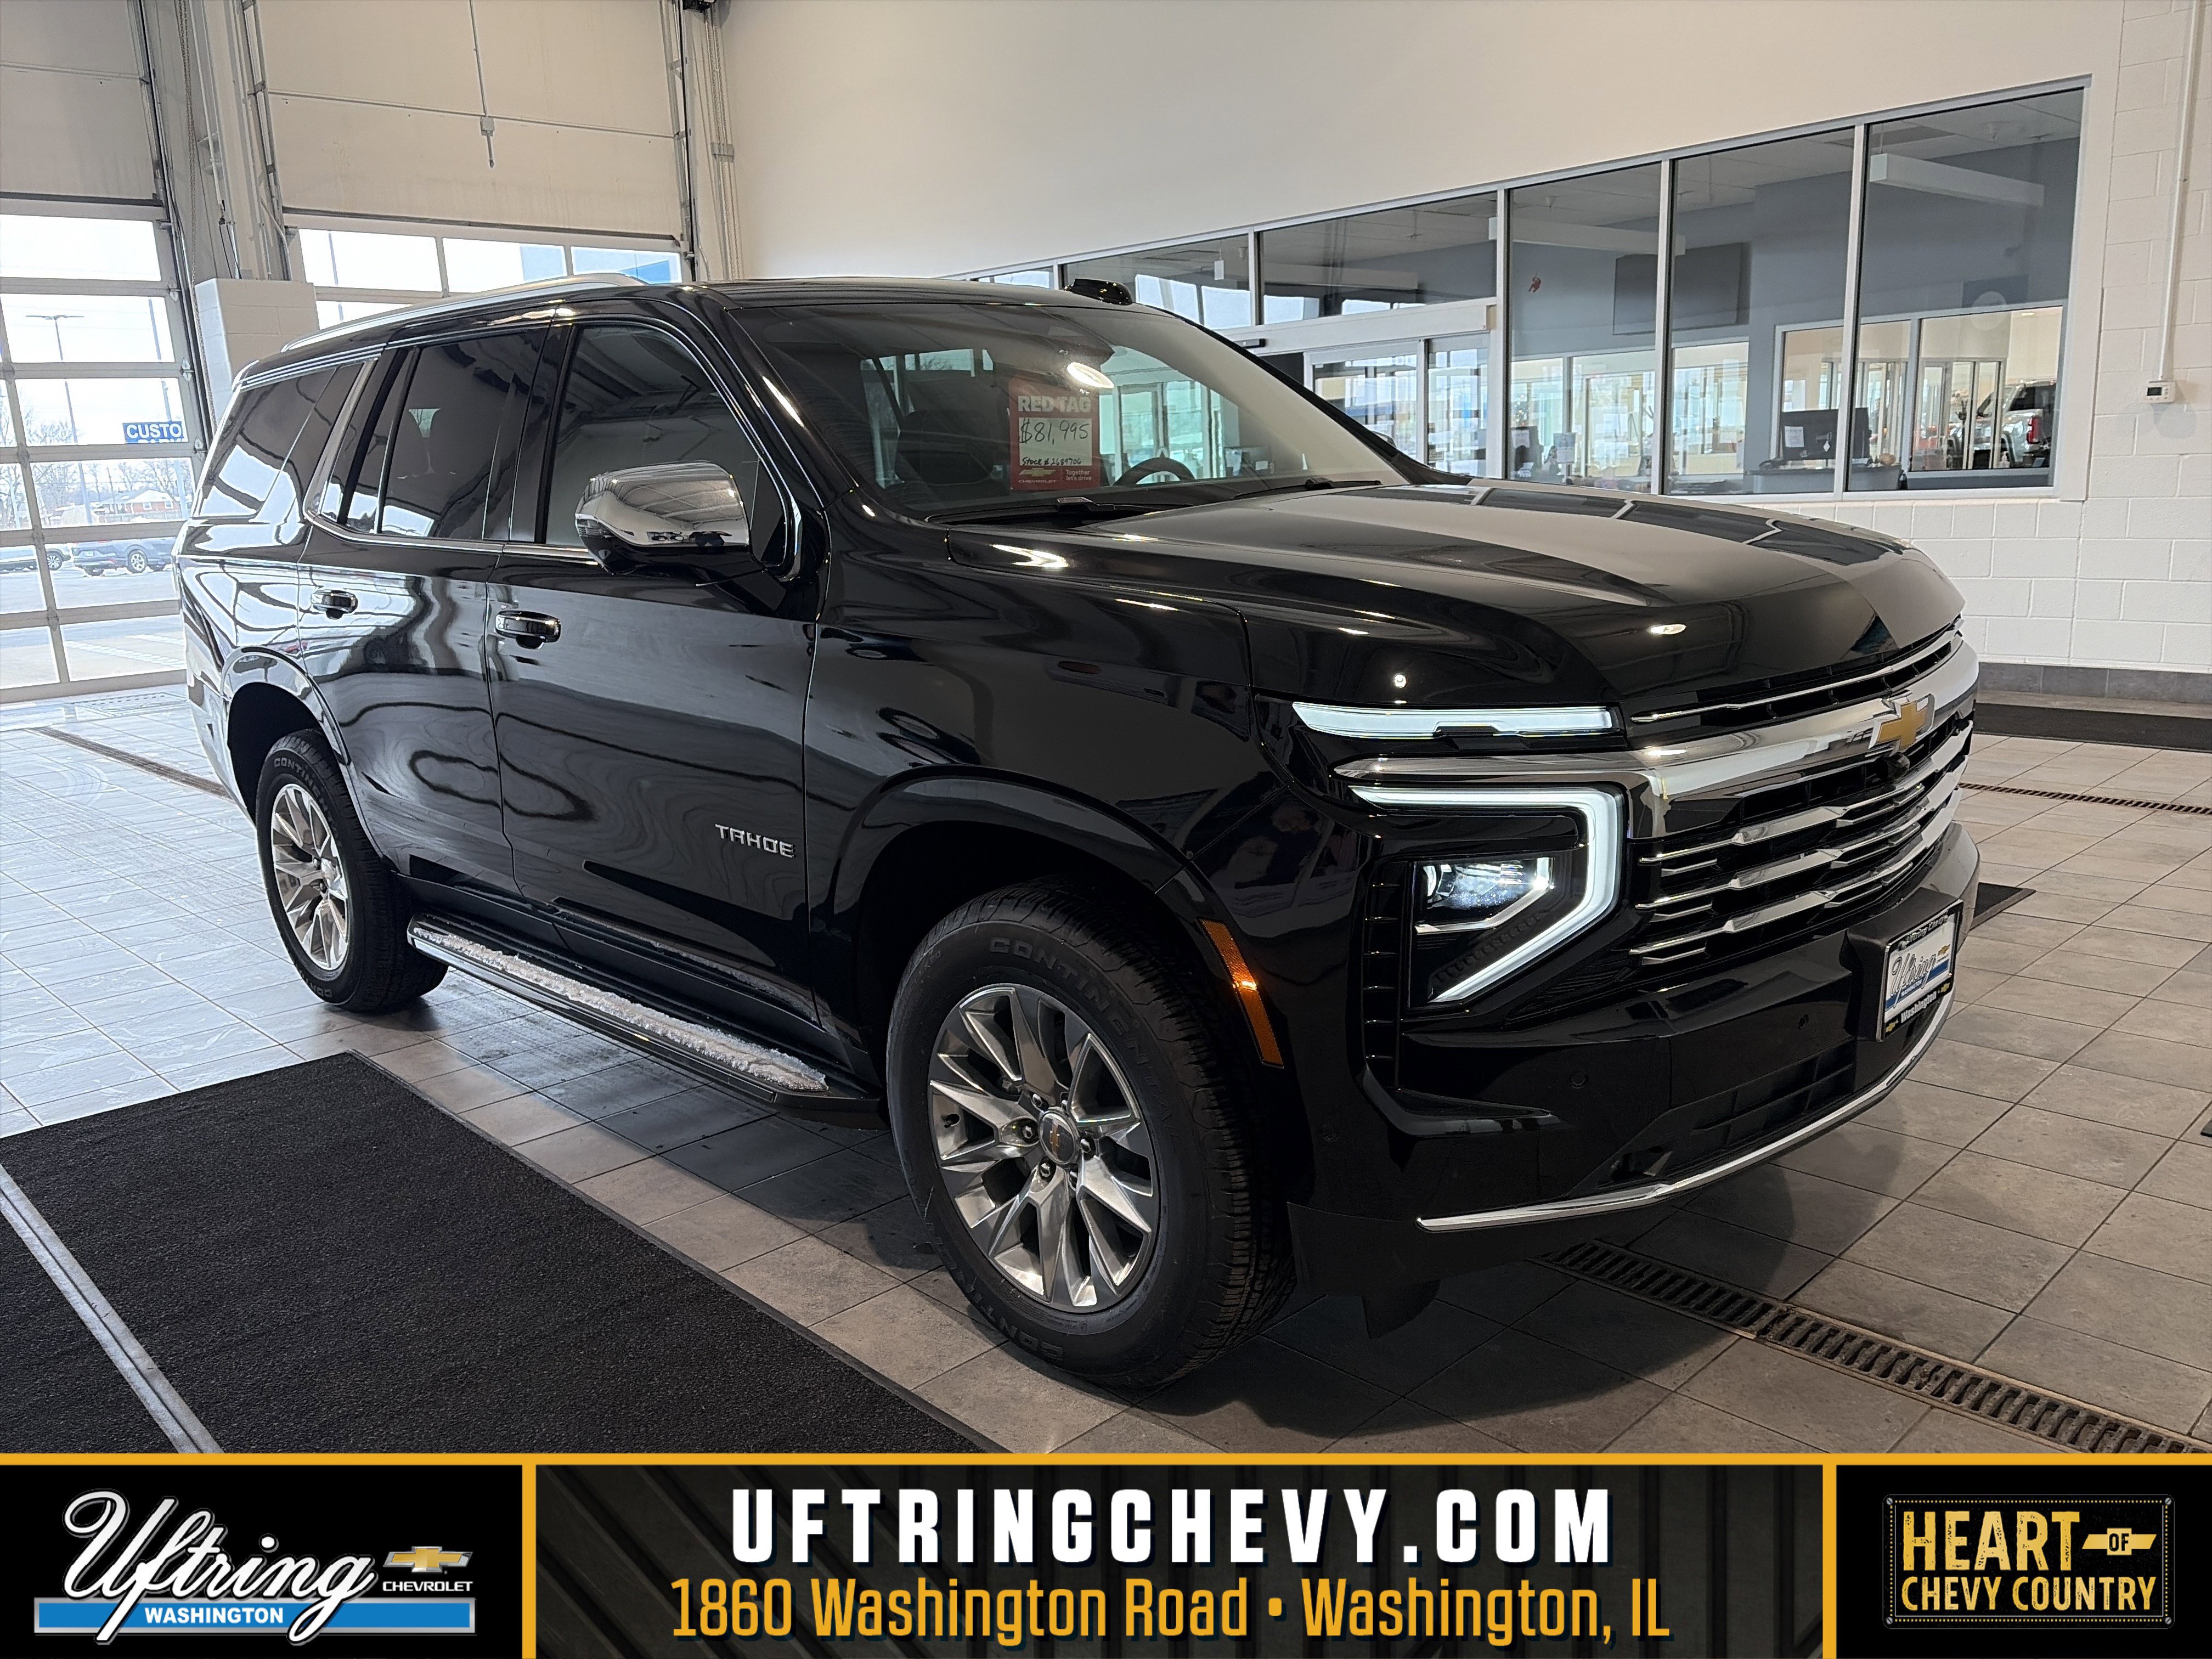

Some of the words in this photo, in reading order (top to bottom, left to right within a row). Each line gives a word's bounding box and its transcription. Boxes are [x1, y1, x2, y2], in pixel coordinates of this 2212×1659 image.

[1018, 396, 1055, 411] RED
[1058, 396, 1092, 413] TAG
[1019, 417, 1090, 445] $81,995
[715, 823, 795, 858] TAHOE
[1900, 991, 1938, 1024] Washington
